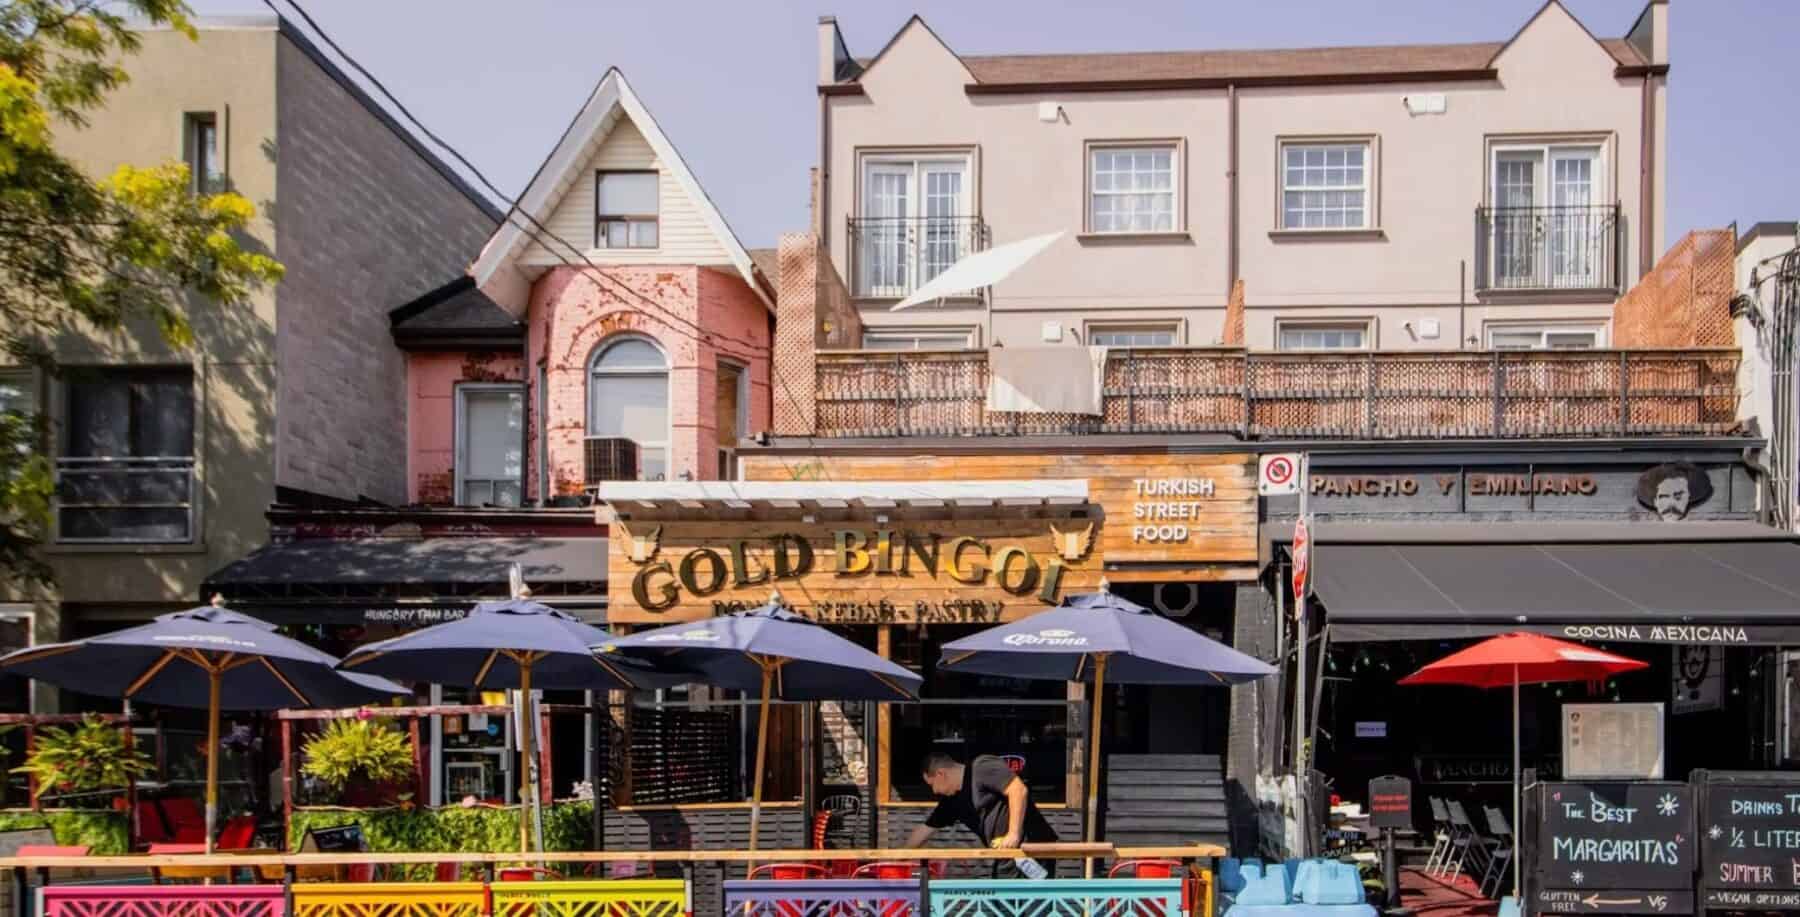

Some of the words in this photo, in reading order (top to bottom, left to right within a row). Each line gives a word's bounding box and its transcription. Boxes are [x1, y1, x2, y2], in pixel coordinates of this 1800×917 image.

[1133, 479, 1214, 496] TURKISH
[1310, 476, 1418, 496] PANCHO
[1435, 477, 1454, 495] Y
[1470, 476, 1598, 497] EMILIANO
[1135, 502, 1200, 519] STREET
[1133, 525, 1187, 543] FOOD
[631, 532, 815, 613] GOLD
[417, 608, 441, 623] THAI
[443, 609, 465, 620] BAR
[1564, 625, 1641, 640] COCINA
[1650, 626, 1748, 642] MEXICANA
[1590, 791, 1638, 824] BEST
[1731, 799, 1784, 815] DRINKS
[1719, 861, 1774, 883] SUMMER
[1551, 902, 1577, 912] FREE
[1648, 895, 1668, 912] VG
